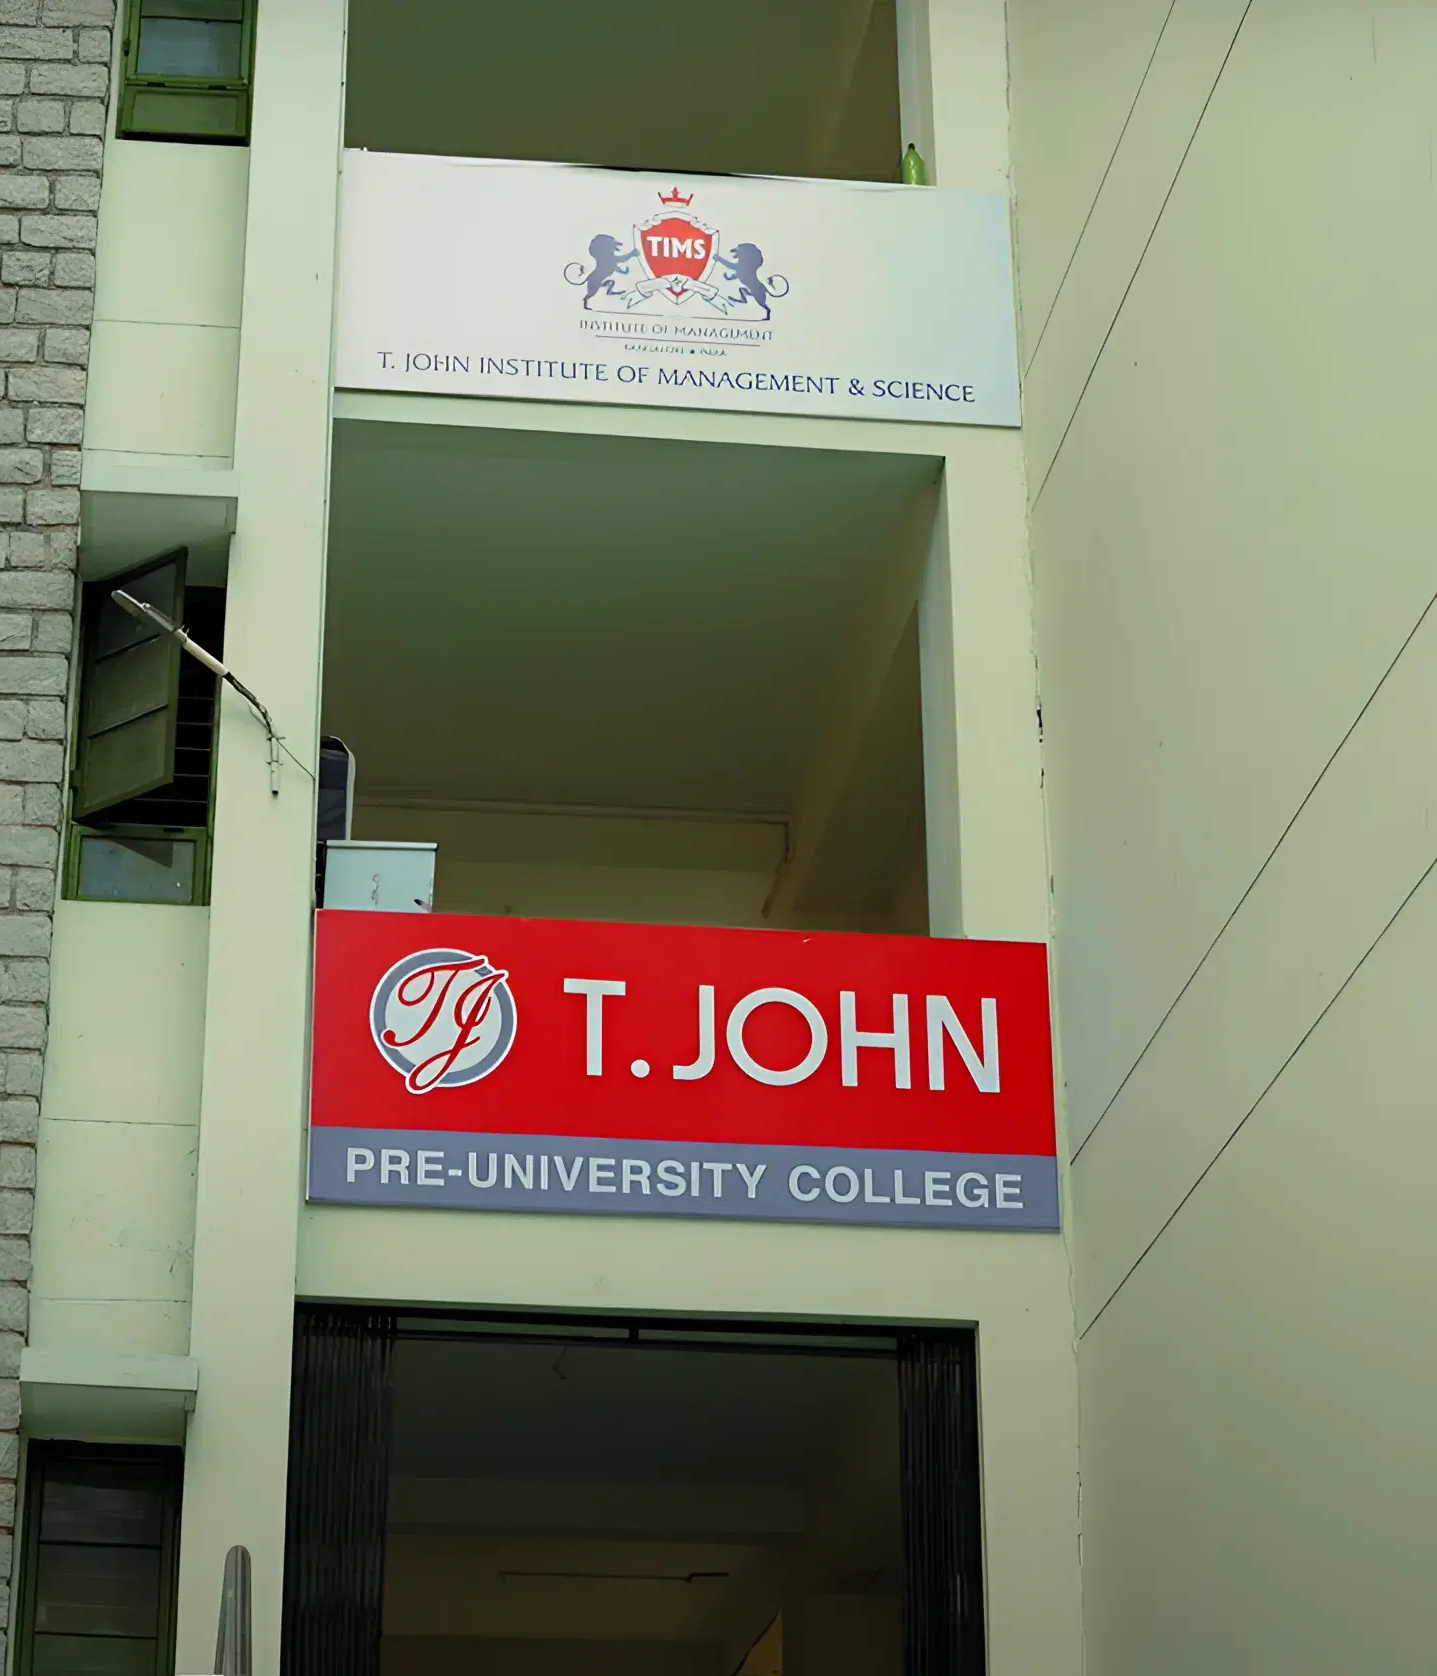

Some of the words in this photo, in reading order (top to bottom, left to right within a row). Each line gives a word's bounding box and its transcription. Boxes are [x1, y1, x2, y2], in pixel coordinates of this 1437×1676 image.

[646, 235, 706, 260] TIMS
[377, 351, 396, 370] T.
[405, 352, 471, 373] JOHN
[479, 356, 609, 382] INSTITUTE
[616, 364, 650, 384] OF
[657, 367, 841, 396] MANAGEMENT
[848, 378, 865, 396] &
[871, 379, 976, 404] SCIENCE
[563, 978, 650, 1079] T.
[673, 984, 1001, 1094] JOHN
[346, 1147, 767, 1199] PRE-UNIVERSITY
[788, 1165, 1024, 1209] COLLEGE
